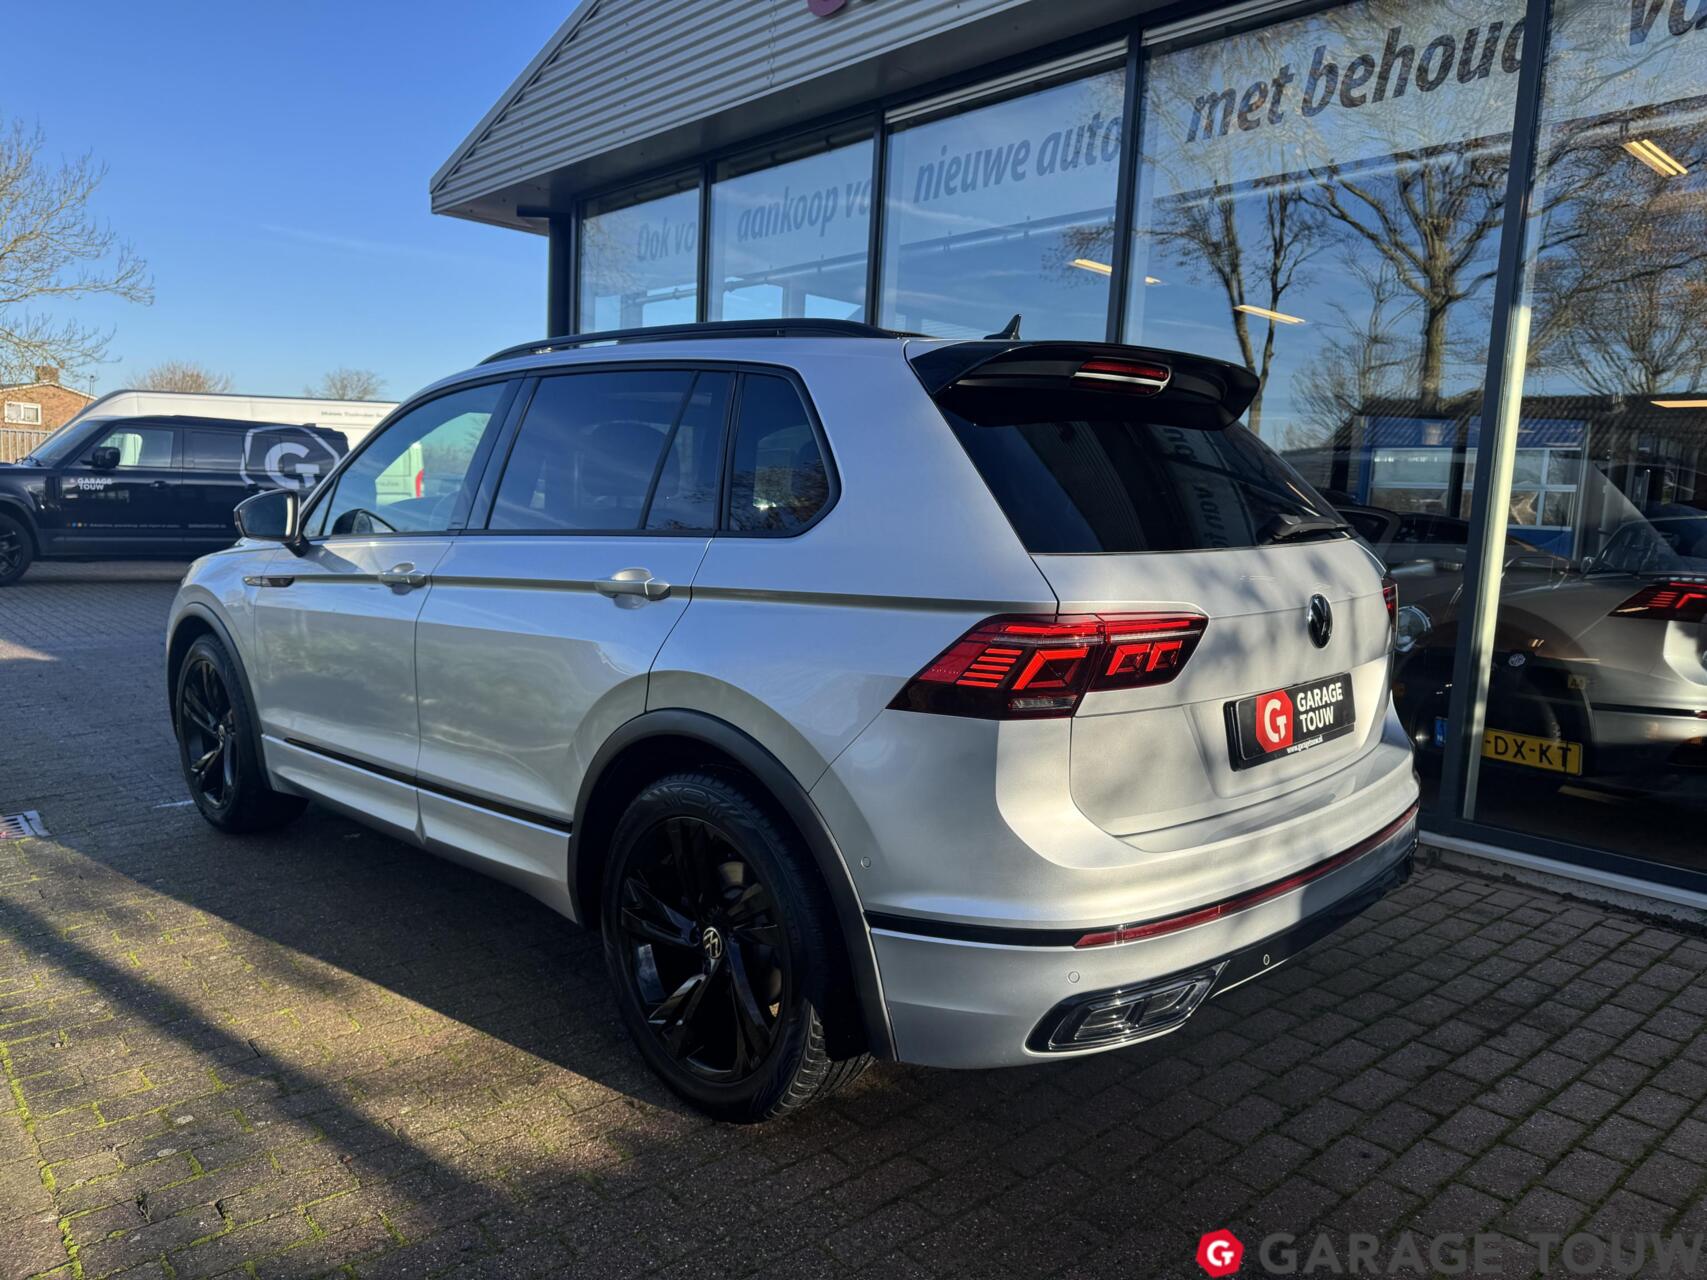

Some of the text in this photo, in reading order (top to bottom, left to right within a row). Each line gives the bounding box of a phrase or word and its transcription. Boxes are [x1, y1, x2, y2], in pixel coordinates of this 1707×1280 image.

[1185, 63, 1296, 143] met
[913, 111, 1122, 204] nieuwe auto
[736, 185, 839, 243] aankoop
[638, 216, 672, 262] Ook
[77, 477, 112, 485] GARAGE
[80, 483, 105, 491] TOUW
[1296, 682, 1344, 712] GARAGE
[1299, 706, 1335, 733] TOUW
